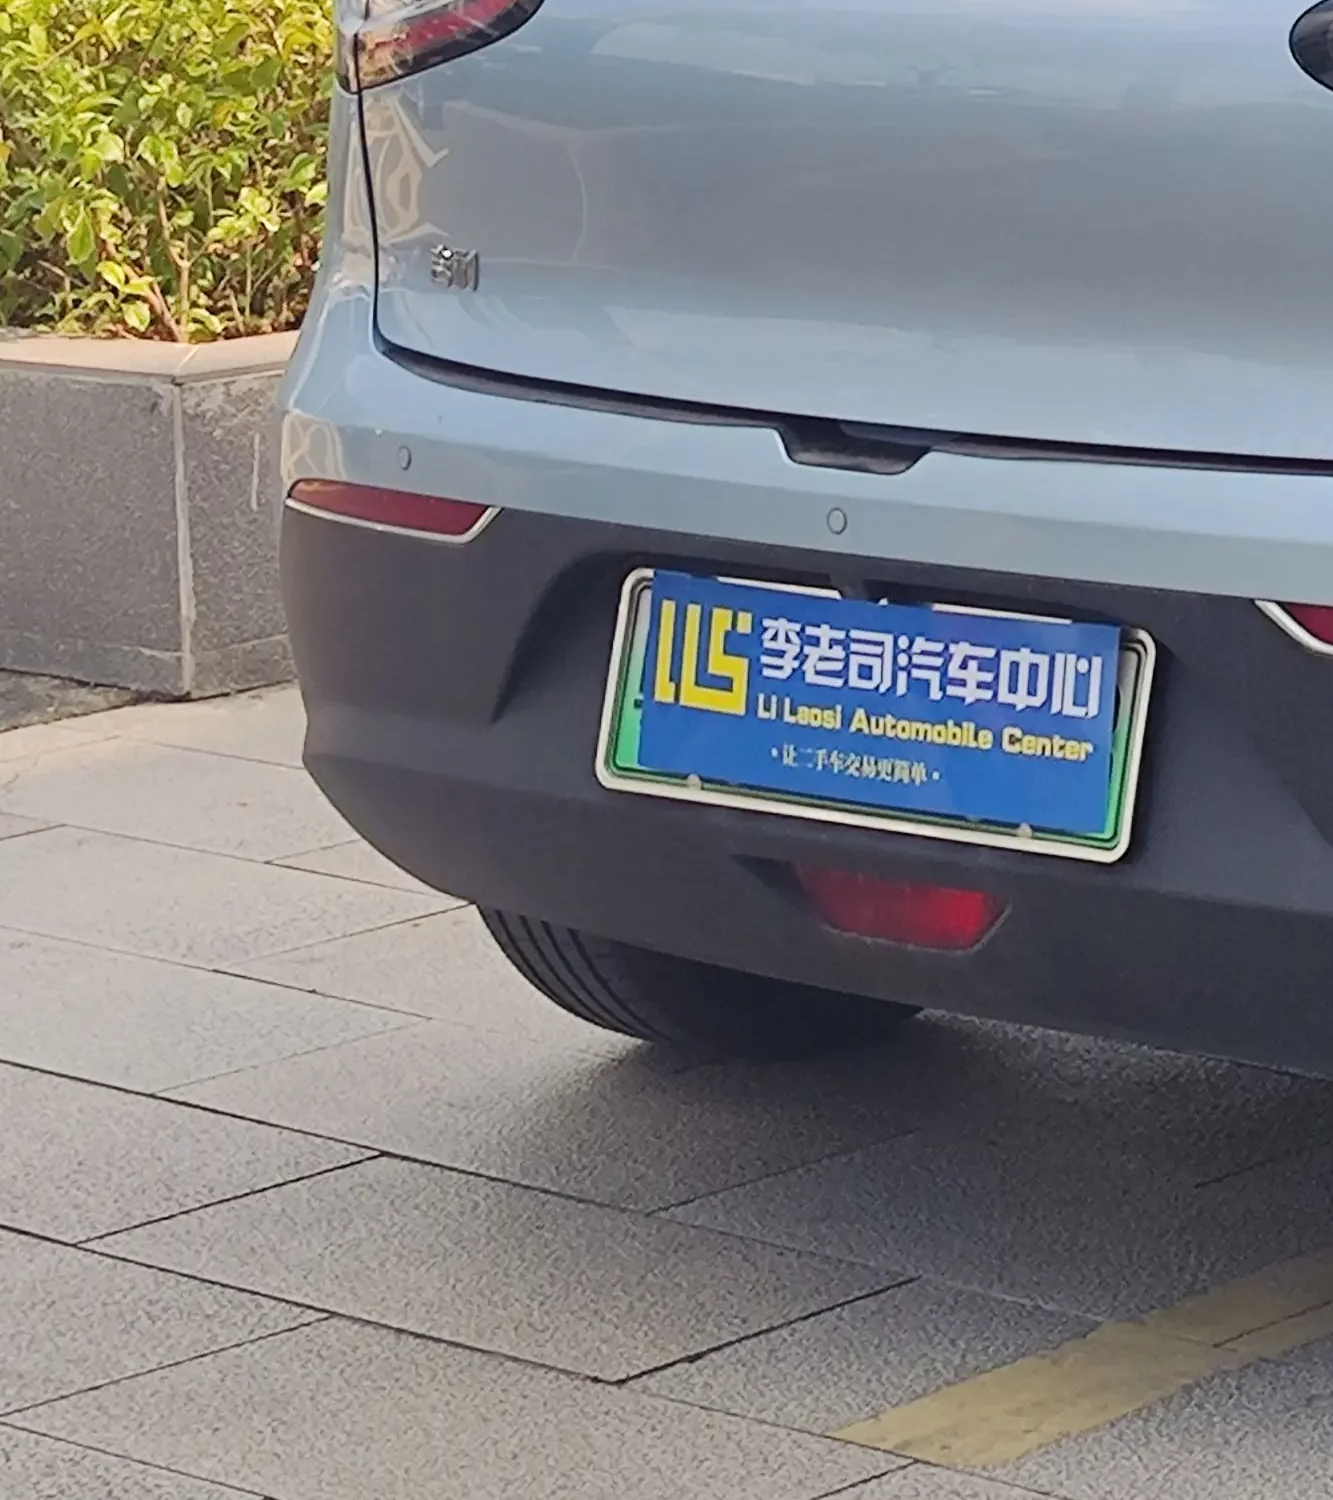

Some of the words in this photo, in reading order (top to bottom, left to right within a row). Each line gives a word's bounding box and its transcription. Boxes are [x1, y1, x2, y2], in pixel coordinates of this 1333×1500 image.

[760, 617, 1102, 720] 李老司汽车中心
[783, 697, 842, 731] Laosi
[849, 707, 994, 750] Automobile
[1001, 726, 1094, 762] Center
